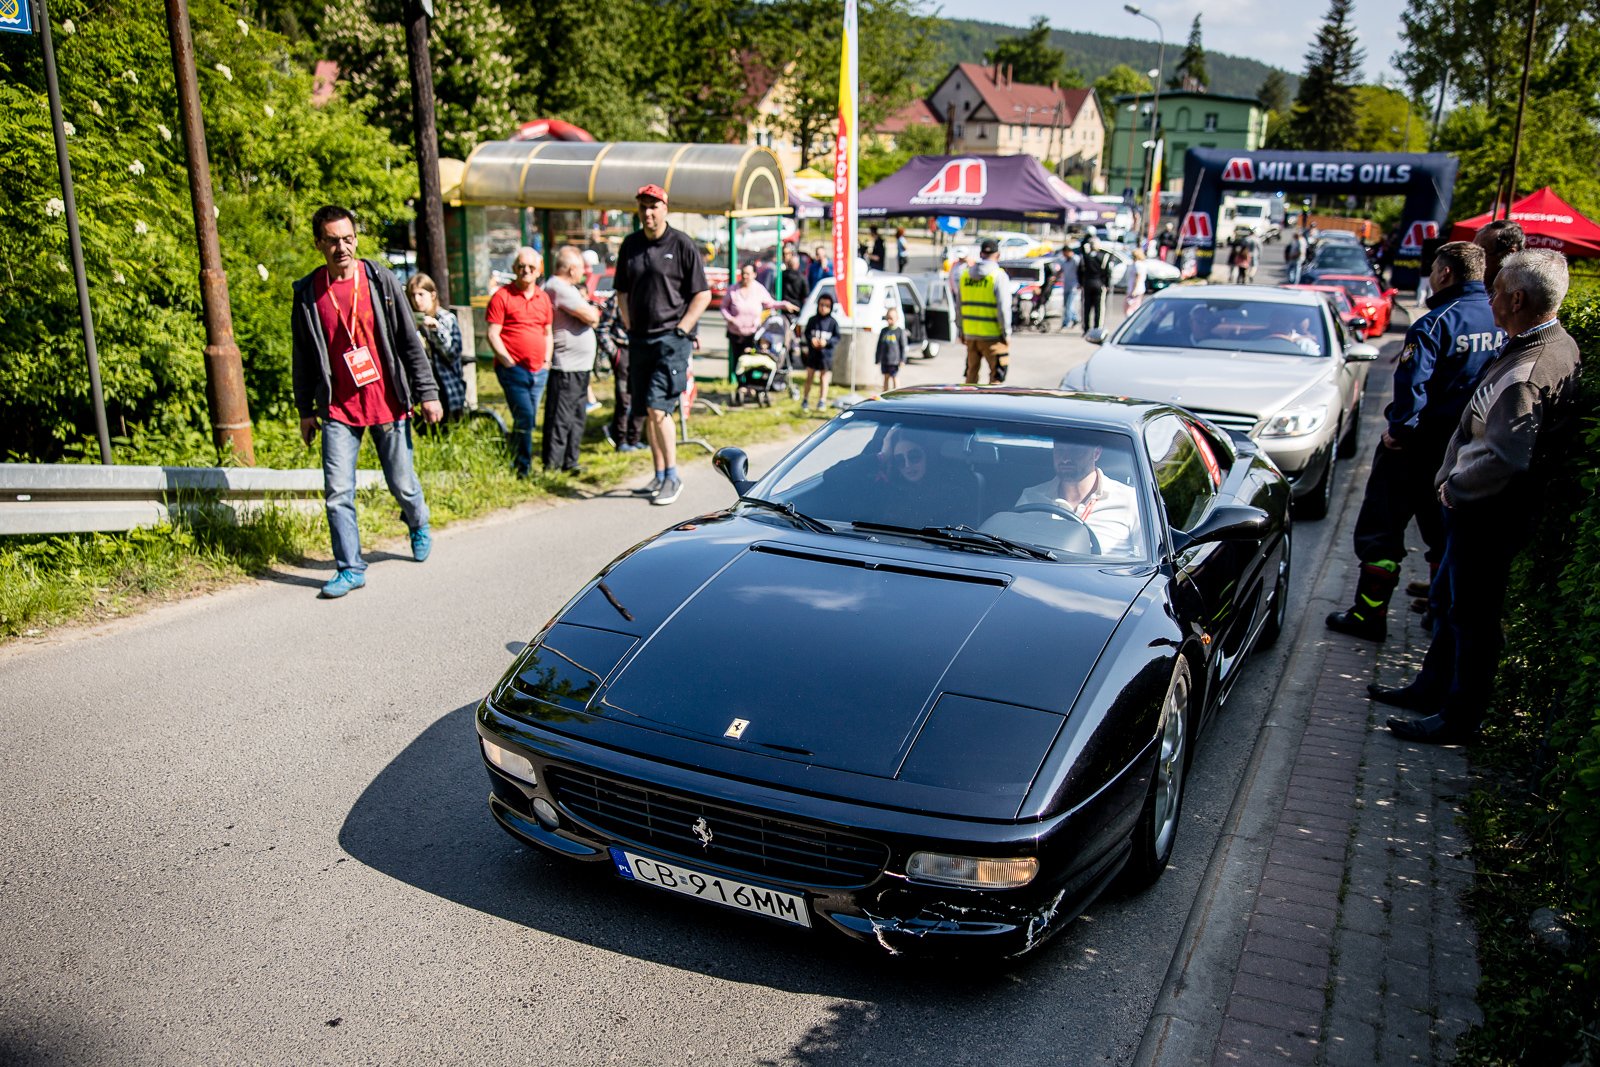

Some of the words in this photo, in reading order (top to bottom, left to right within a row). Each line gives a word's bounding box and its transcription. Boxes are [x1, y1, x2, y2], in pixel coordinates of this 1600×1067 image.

[1258, 161, 1354, 182] MILLERS
[1359, 163, 1412, 183] OILS
[1456, 330, 1508, 353] STRA
[618, 864, 631, 873] PL
